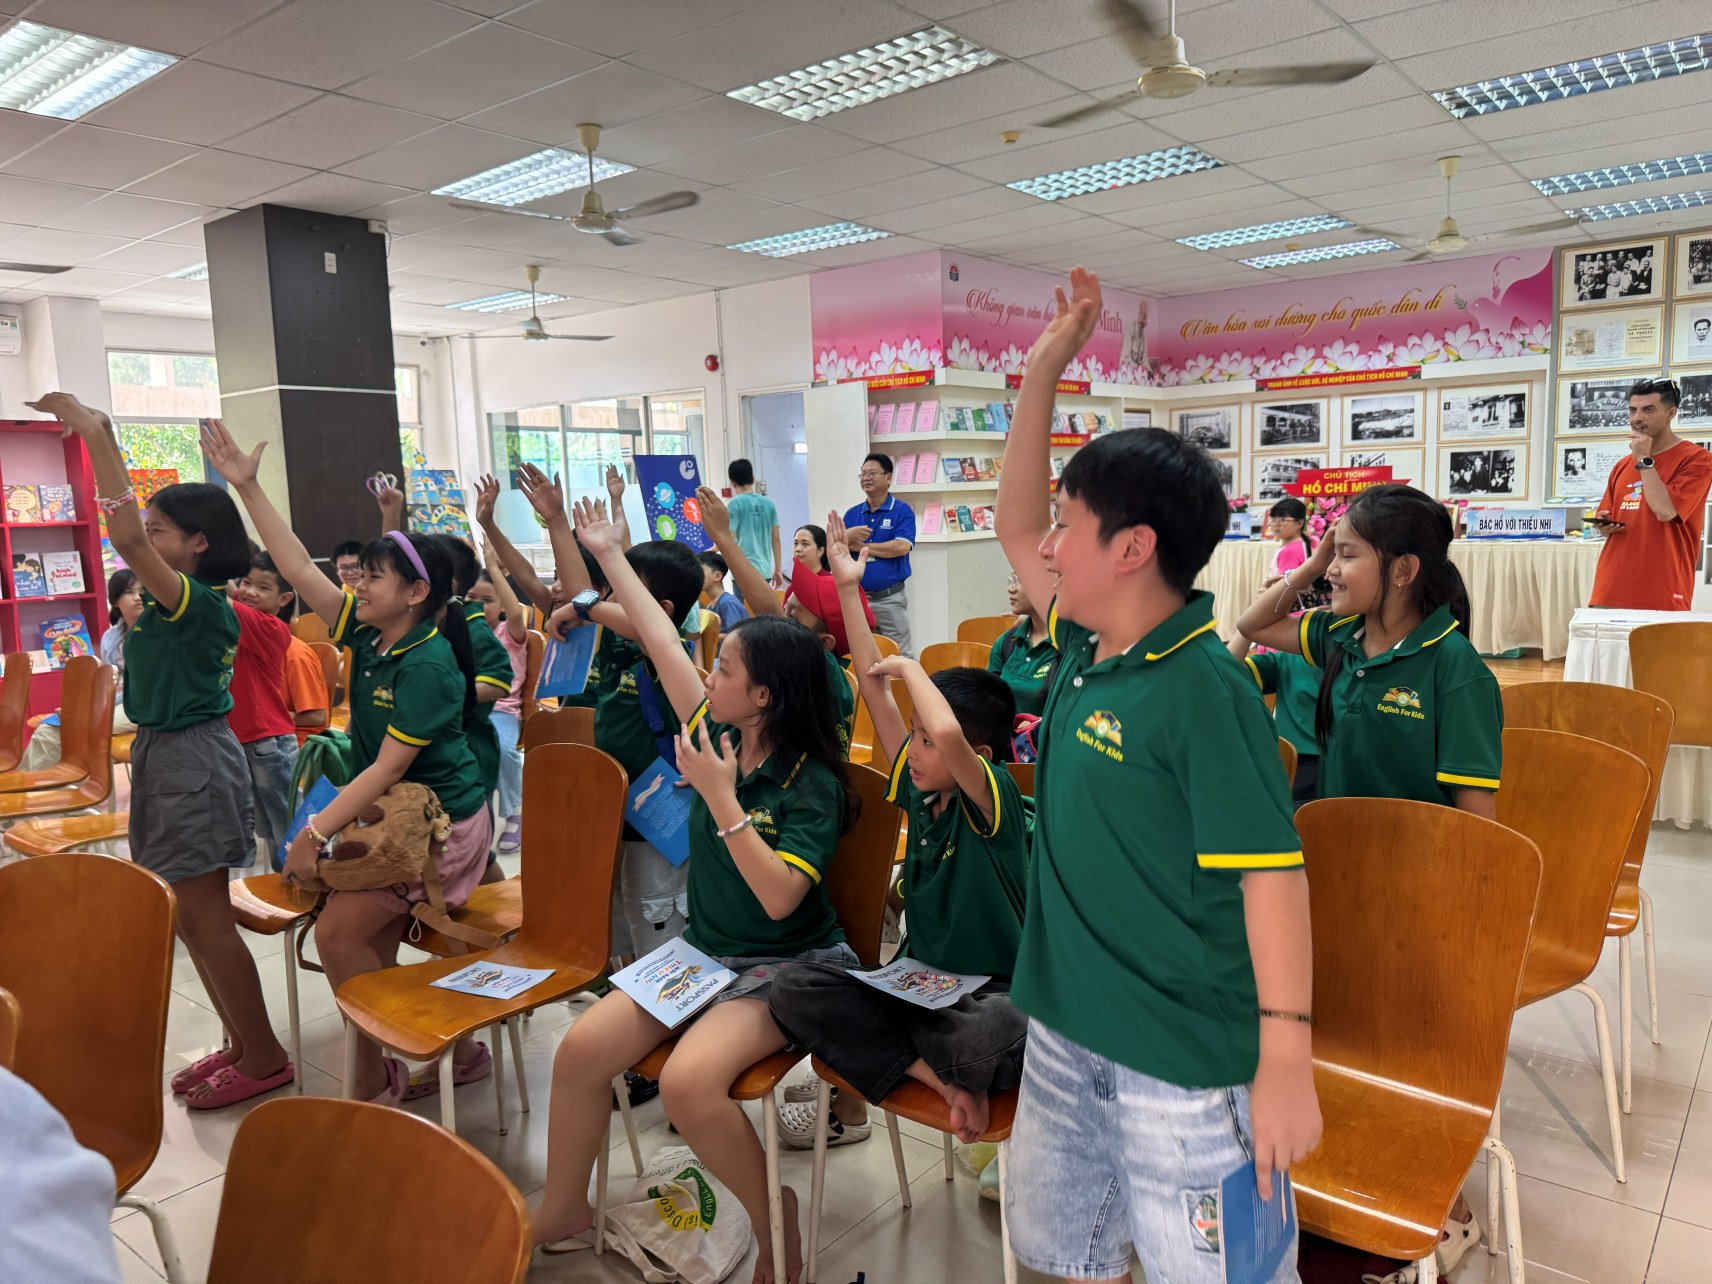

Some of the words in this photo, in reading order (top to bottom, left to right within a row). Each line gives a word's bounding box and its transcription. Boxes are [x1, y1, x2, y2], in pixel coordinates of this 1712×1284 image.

[1321, 296, 1353, 321] cho
[1349, 300, 1386, 331] quốc
[1390, 288, 1422, 314] dân
[1324, 470, 1342, 479] CHỦ
[1344, 470, 1365, 481] TỊCH
[1302, 480, 1322, 494] HỒ
[1324, 480, 1348, 493] CHÍ
[1480, 516, 1492, 530] BÁC
[1494, 515, 1504, 529] HỒ
[1505, 516, 1516, 529] VỚI
[1518, 514, 1538, 530] THIẾU
[1540, 518, 1551, 530] NHI
[1377, 703, 1399, 714] English
[1400, 708, 1411, 717] For
[1411, 711, 1425, 719] Kids
[765, 826, 777, 834] Kids
[675, 978, 719, 1012] PASSPORT
